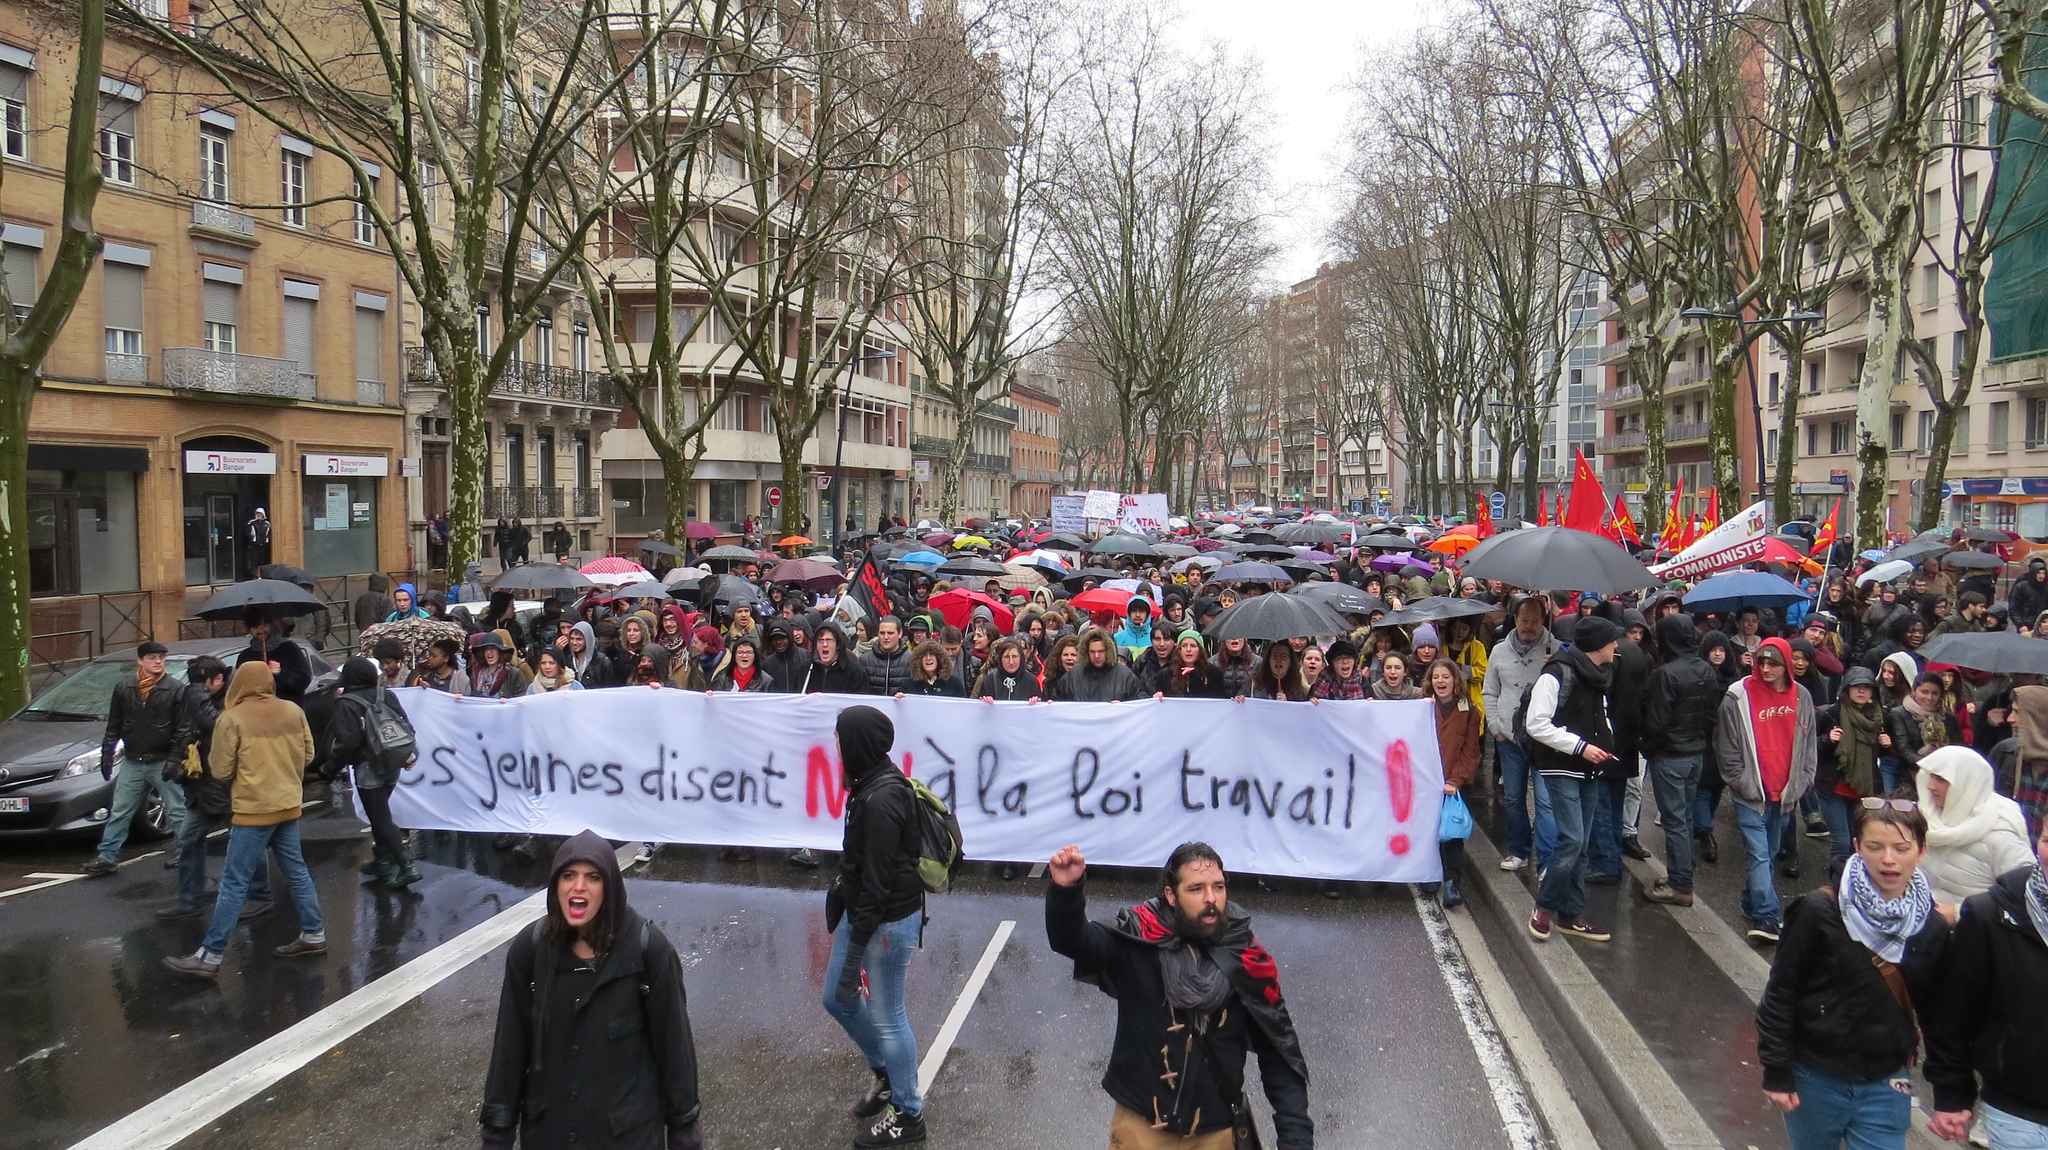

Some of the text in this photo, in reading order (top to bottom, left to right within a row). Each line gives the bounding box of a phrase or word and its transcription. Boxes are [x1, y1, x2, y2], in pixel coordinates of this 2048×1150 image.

[476, 731, 624, 811] jeunes
[640, 743, 788, 809] disent
[977, 744, 1030, 818] la
[1069, 746, 1144, 820] loi
[1180, 748, 1357, 830] travail
